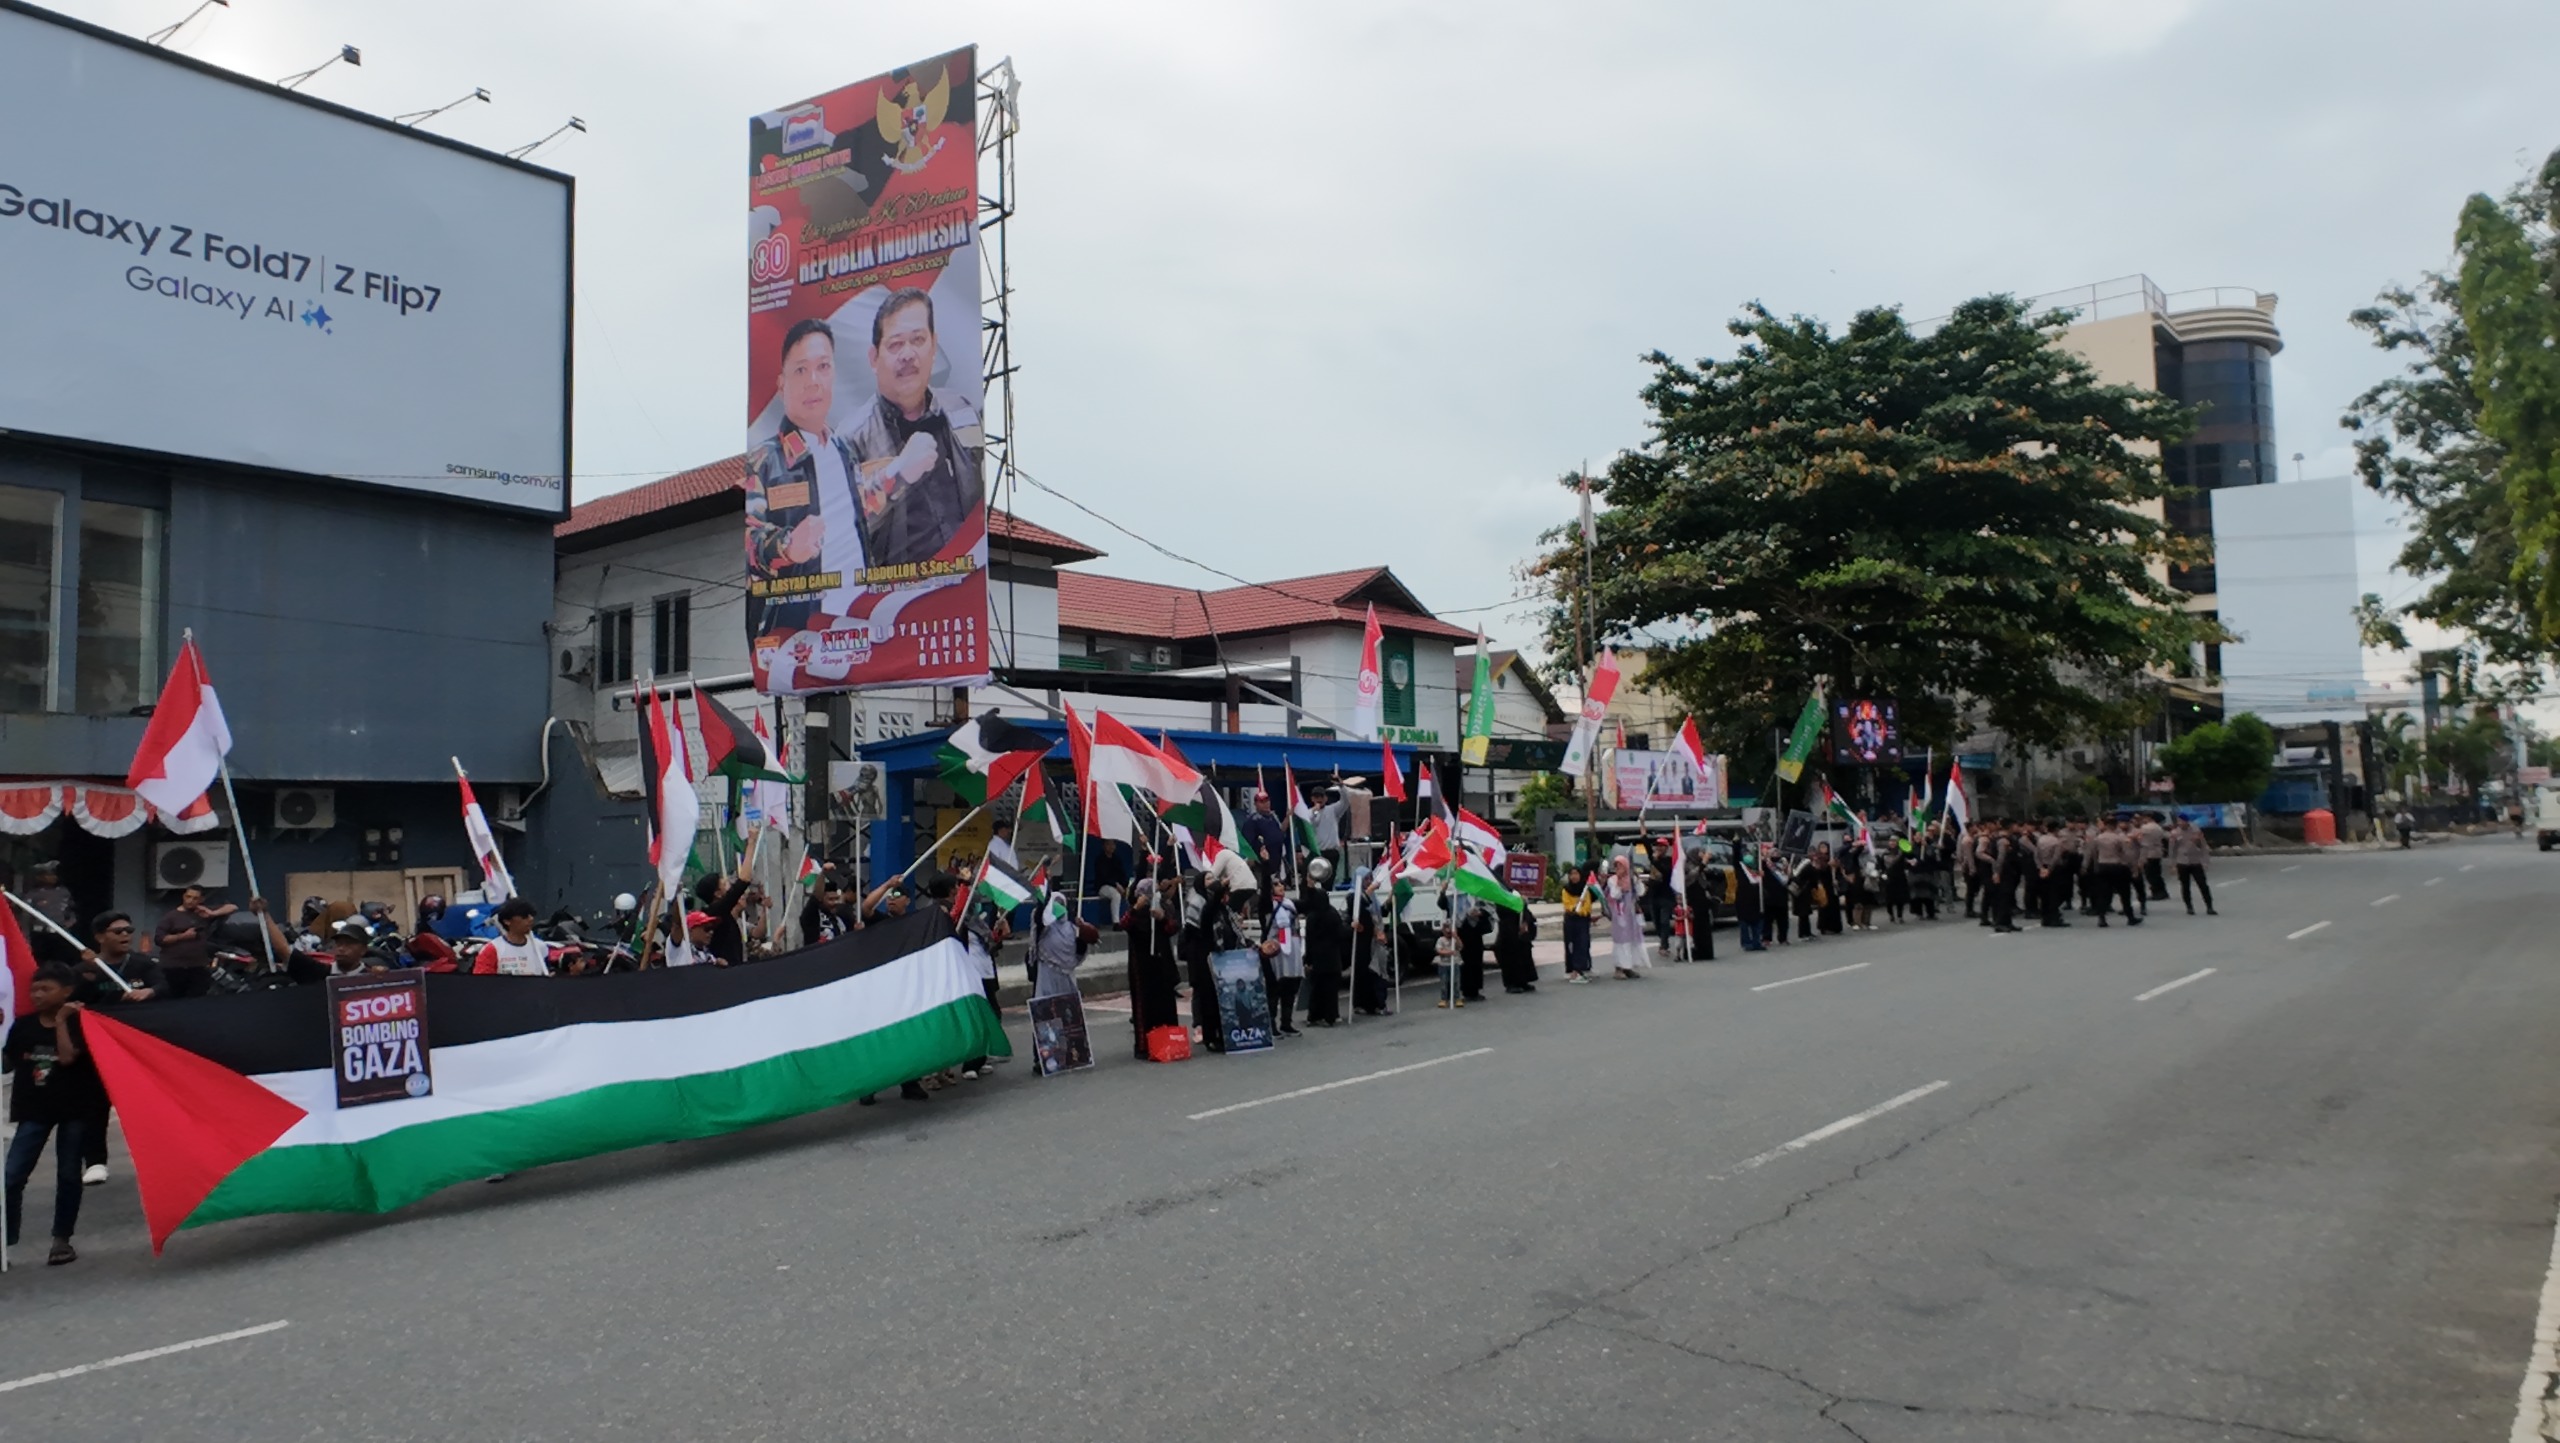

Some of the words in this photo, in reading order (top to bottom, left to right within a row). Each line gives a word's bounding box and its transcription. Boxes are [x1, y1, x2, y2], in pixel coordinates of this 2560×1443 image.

[0, 184, 161, 255] Galaxy
[169, 224, 192, 257] Z
[203, 232, 311, 283] Fold7
[334, 264, 354, 294] Z
[364, 271, 442, 316] Flip7
[799, 235, 877, 284] REPUBLIK
[877, 208, 970, 265] INDONESIA
[125, 265, 256, 320] Galaxy
[264, 296, 294, 323] AI
[445, 461, 561, 491] samsung.com/id
[820, 627, 869, 653] NKRI
[876, 616, 975, 640] LOYALITAS
[919, 633, 975, 651] TANPA
[919, 649, 975, 666] BATAS
[345, 992, 412, 1021] STOP!
[341, 1018, 419, 1047] BOMBING
[343, 1039, 423, 1083] GAZA
